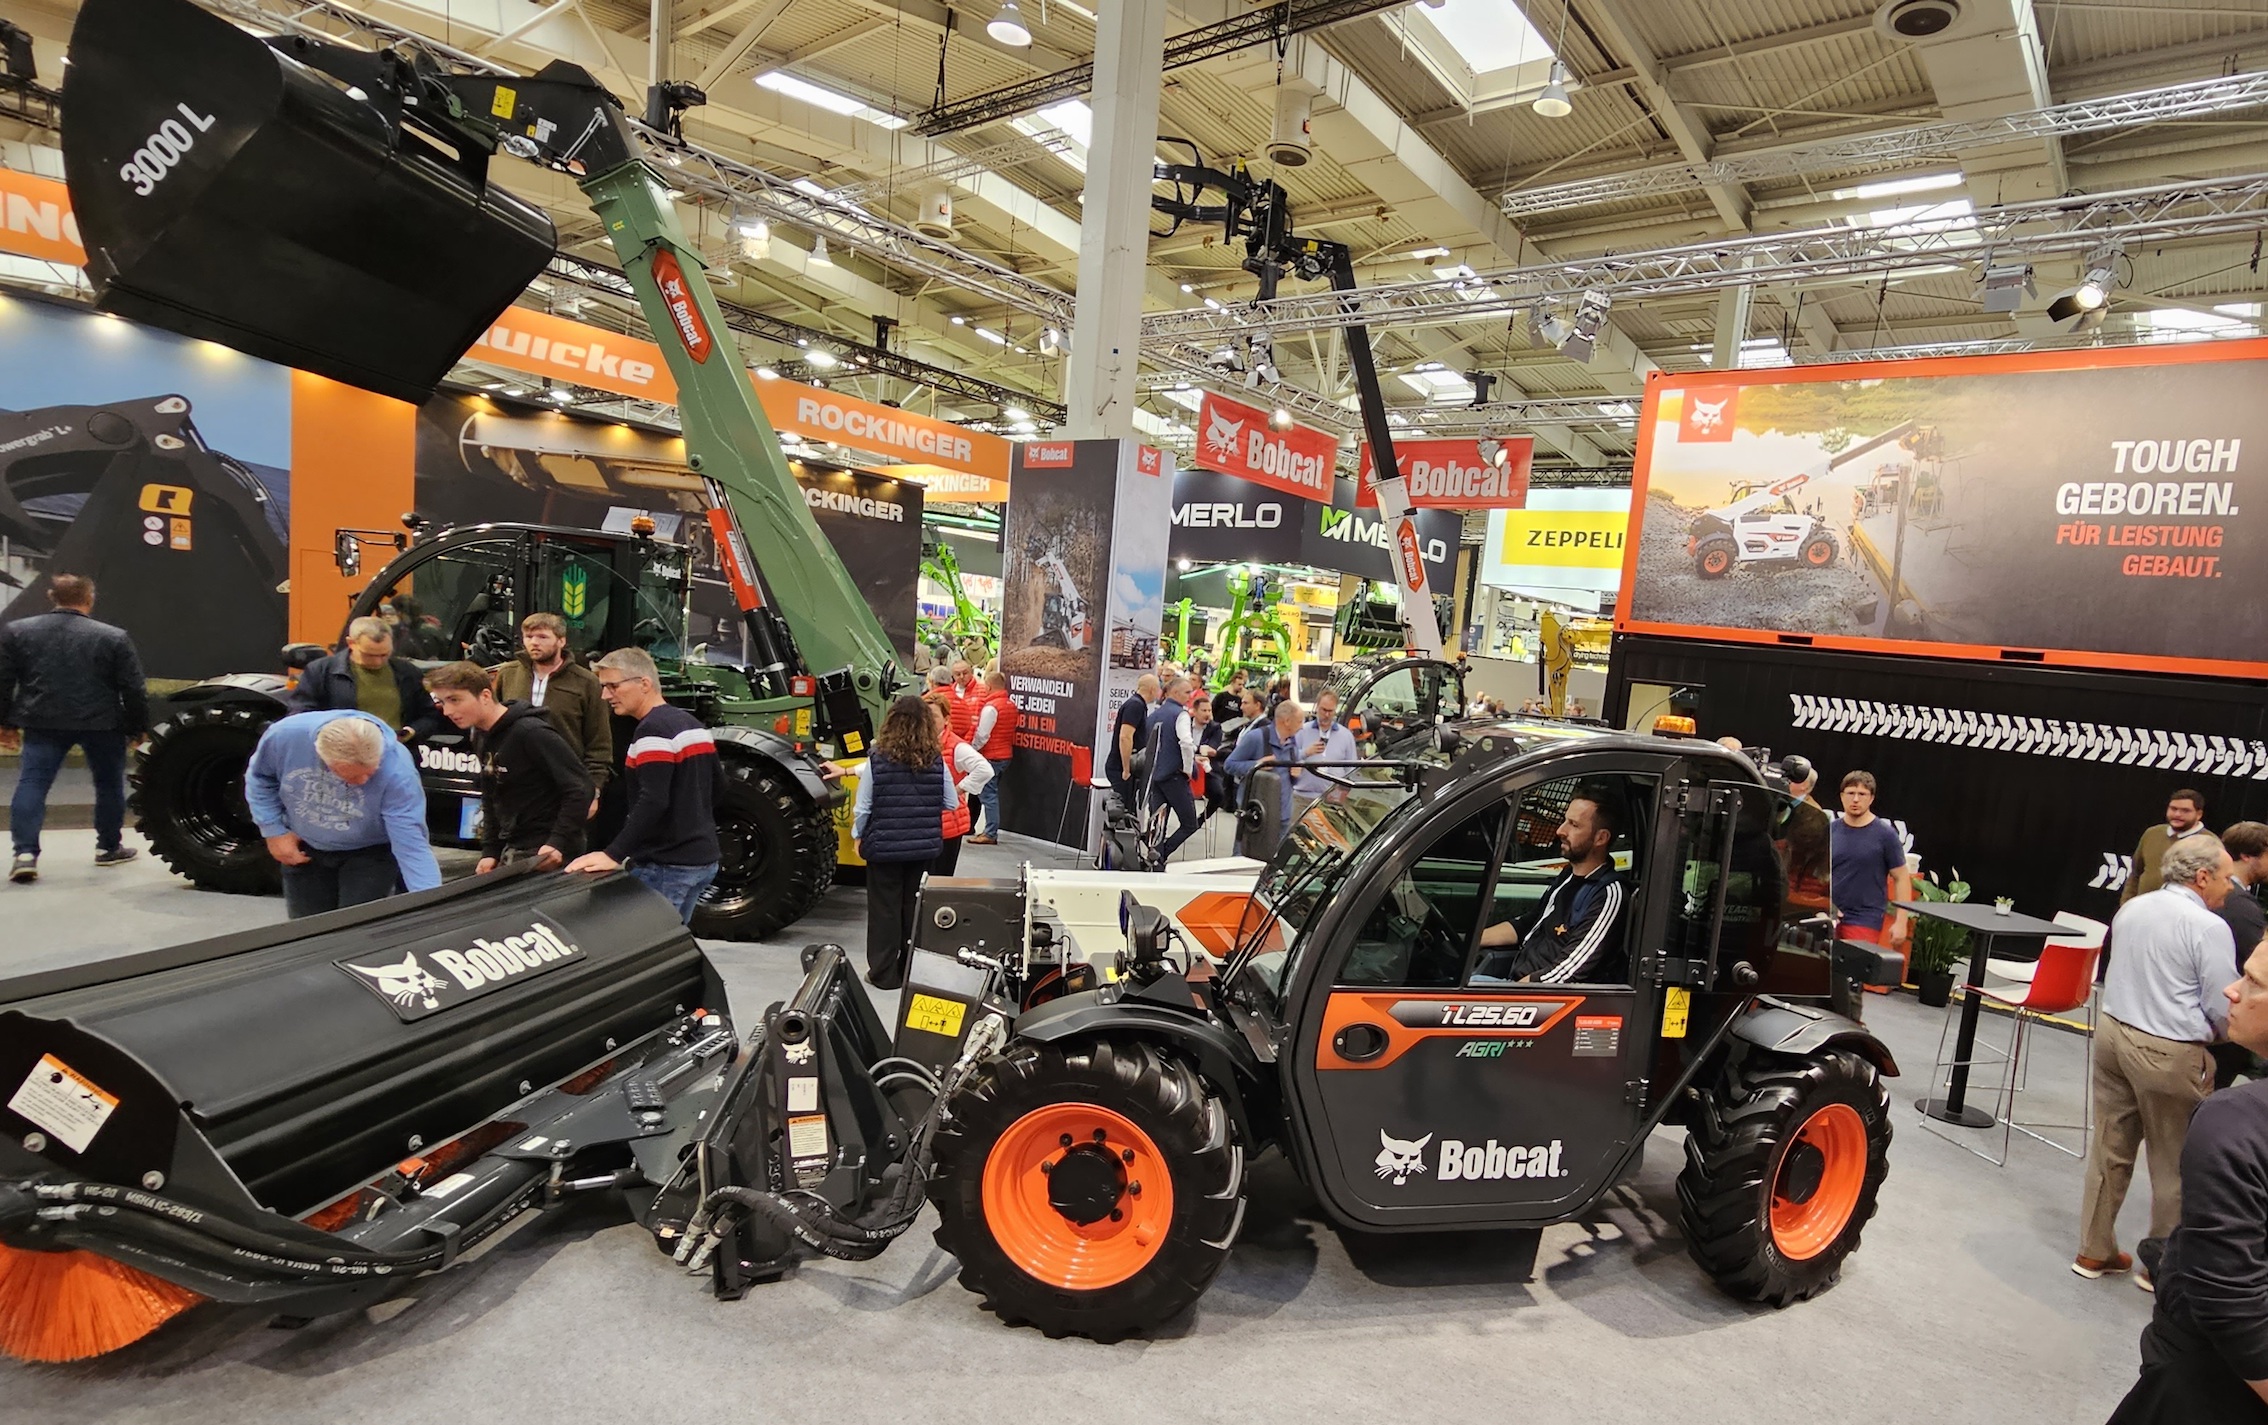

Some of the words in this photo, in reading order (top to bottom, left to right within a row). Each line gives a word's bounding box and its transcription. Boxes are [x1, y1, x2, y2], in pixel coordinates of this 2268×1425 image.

[119, 119, 194, 197] 3000
[176, 102, 217, 133] L
[672, 300, 703, 346] Bobcat
[797, 397, 972, 463] ROCKINGER
[1040, 447, 1068, 461] Bobcat
[1246, 430, 1326, 490] Bobcat
[2111, 438, 2241, 474] TOUGH
[1409, 460, 1513, 498] Bobcat
[2055, 481, 2240, 516] GEBOREN.
[1353, 517, 1447, 564] MELO
[2056, 520, 2102, 546] FÜR
[2107, 525, 2224, 548] LEISTUNG
[1404, 551, 1419, 583] Bobcat
[2122, 554, 2223, 578] GEBAUT.
[1010, 675, 1074, 698] VERWANDELN
[1109, 688, 1129, 698] SEIEN
[1025, 696, 1056, 714] JEDEN
[1028, 716, 1039, 731] IN
[1040, 718, 1056, 733] EIN
[1012, 734, 1073, 756] EISTERWERK
[428, 922, 573, 991] Bobcat
[1441, 1005, 1538, 1026] TL25.60
[1455, 1041, 1508, 1058] AGRI
[1437, 1139, 1564, 1181] Bobcat
